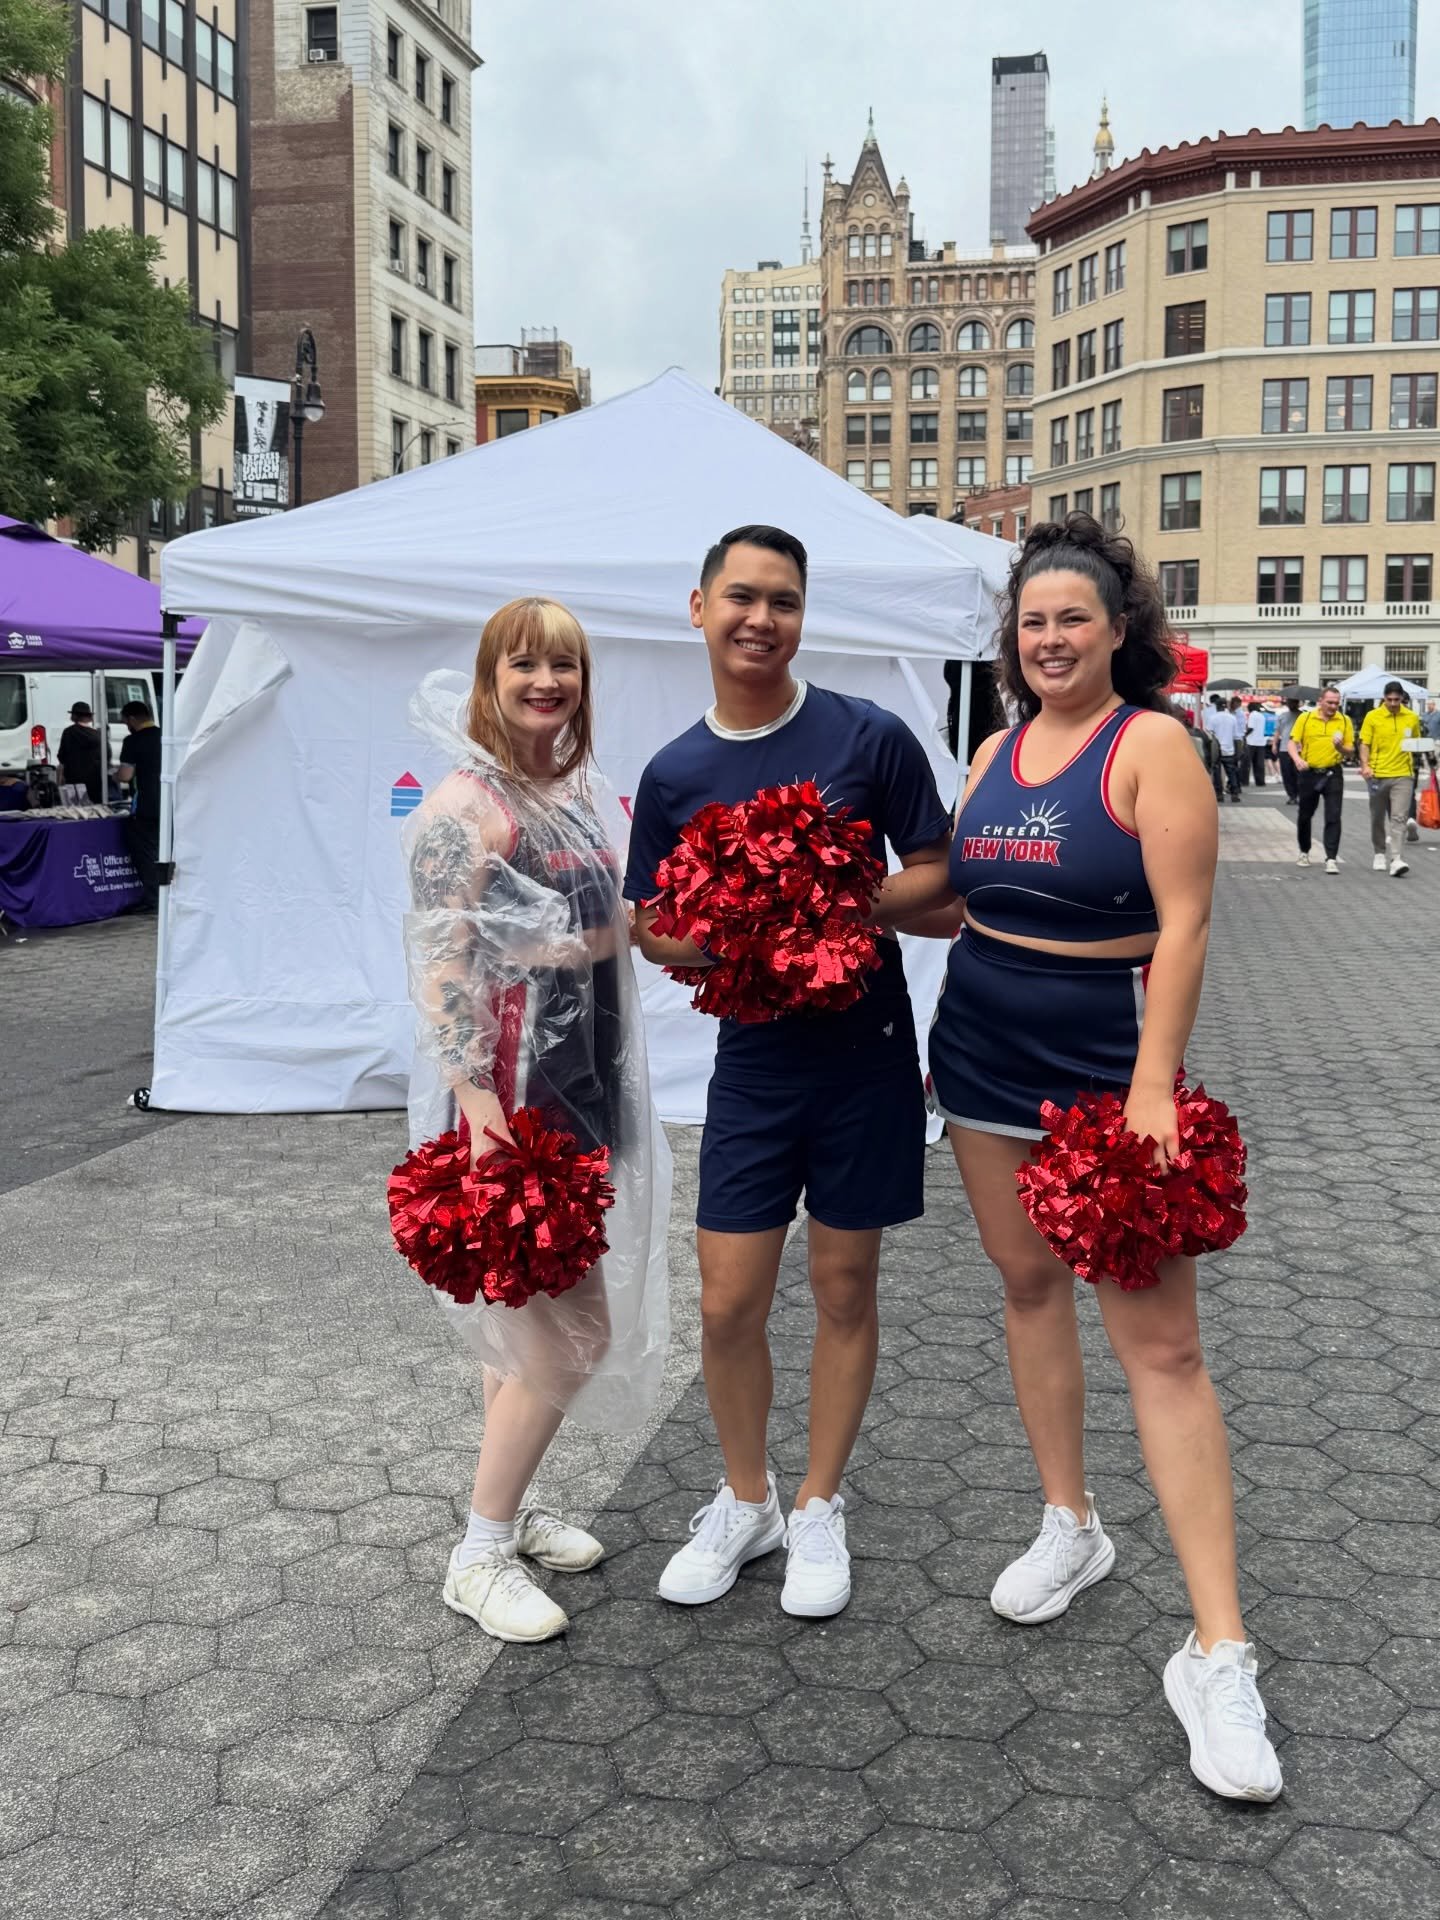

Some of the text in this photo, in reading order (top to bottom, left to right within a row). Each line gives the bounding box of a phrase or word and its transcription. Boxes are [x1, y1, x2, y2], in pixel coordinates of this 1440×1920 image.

[243, 463, 279, 474] UNION
[243, 471, 279, 481] SQUARE
[982, 825, 1039, 836] CHEER
[961, 837, 1061, 867] NEW YORK
[104, 855, 123, 865] Office
[105, 867, 132, 877] Services
